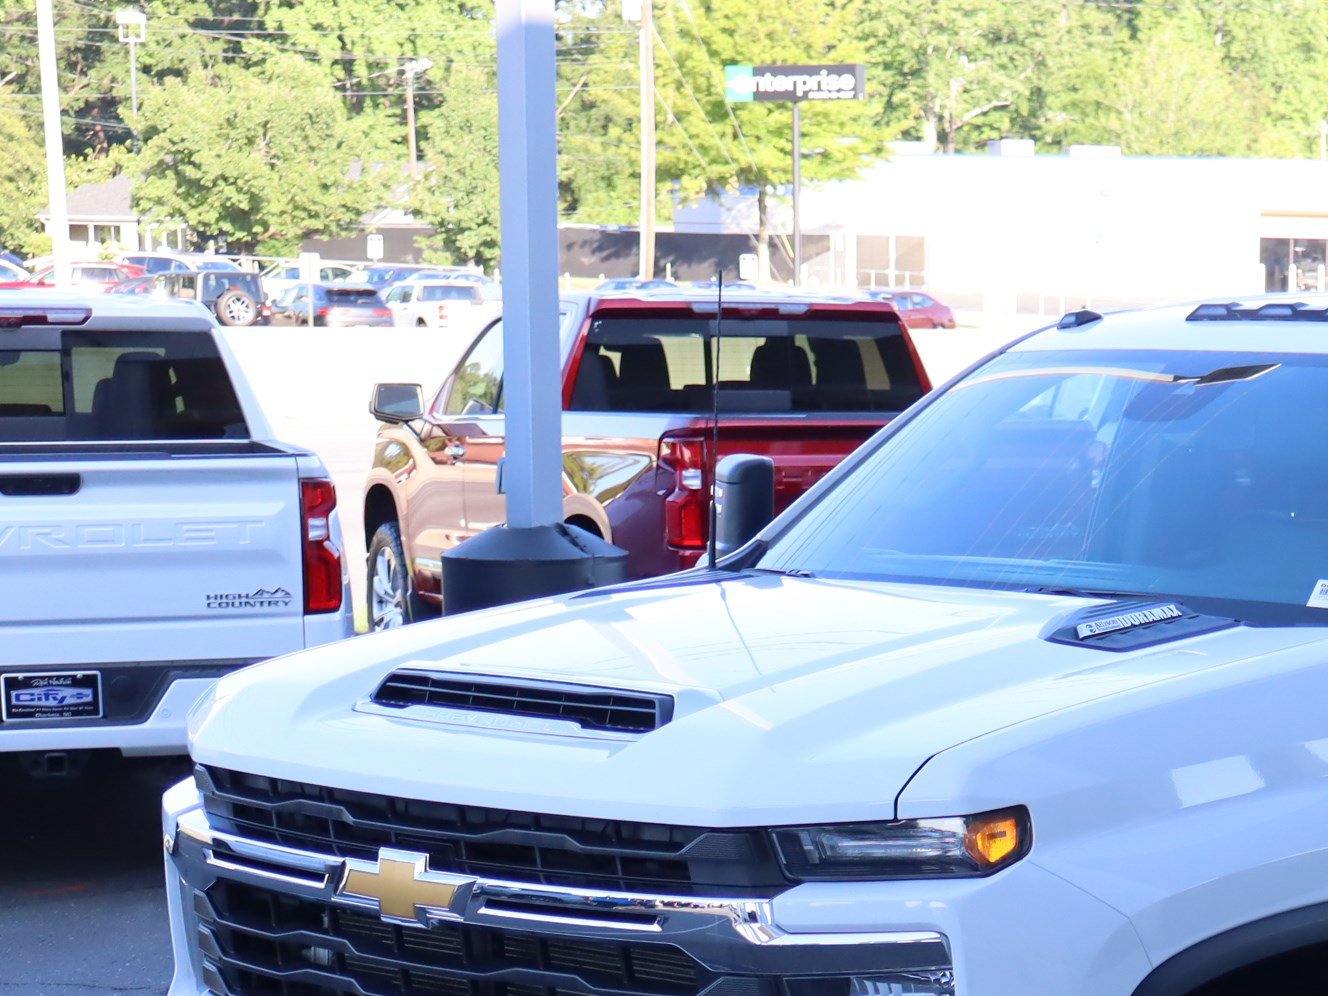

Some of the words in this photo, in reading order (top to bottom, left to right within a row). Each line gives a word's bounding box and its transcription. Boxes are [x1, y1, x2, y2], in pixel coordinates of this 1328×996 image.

[731, 69, 856, 97] enterprise
[206, 592, 251, 601] HIGH
[206, 599, 293, 609] COUNTRY
[1118, 604, 1183, 628] DURAMAX
[15, 692, 68, 704] City
